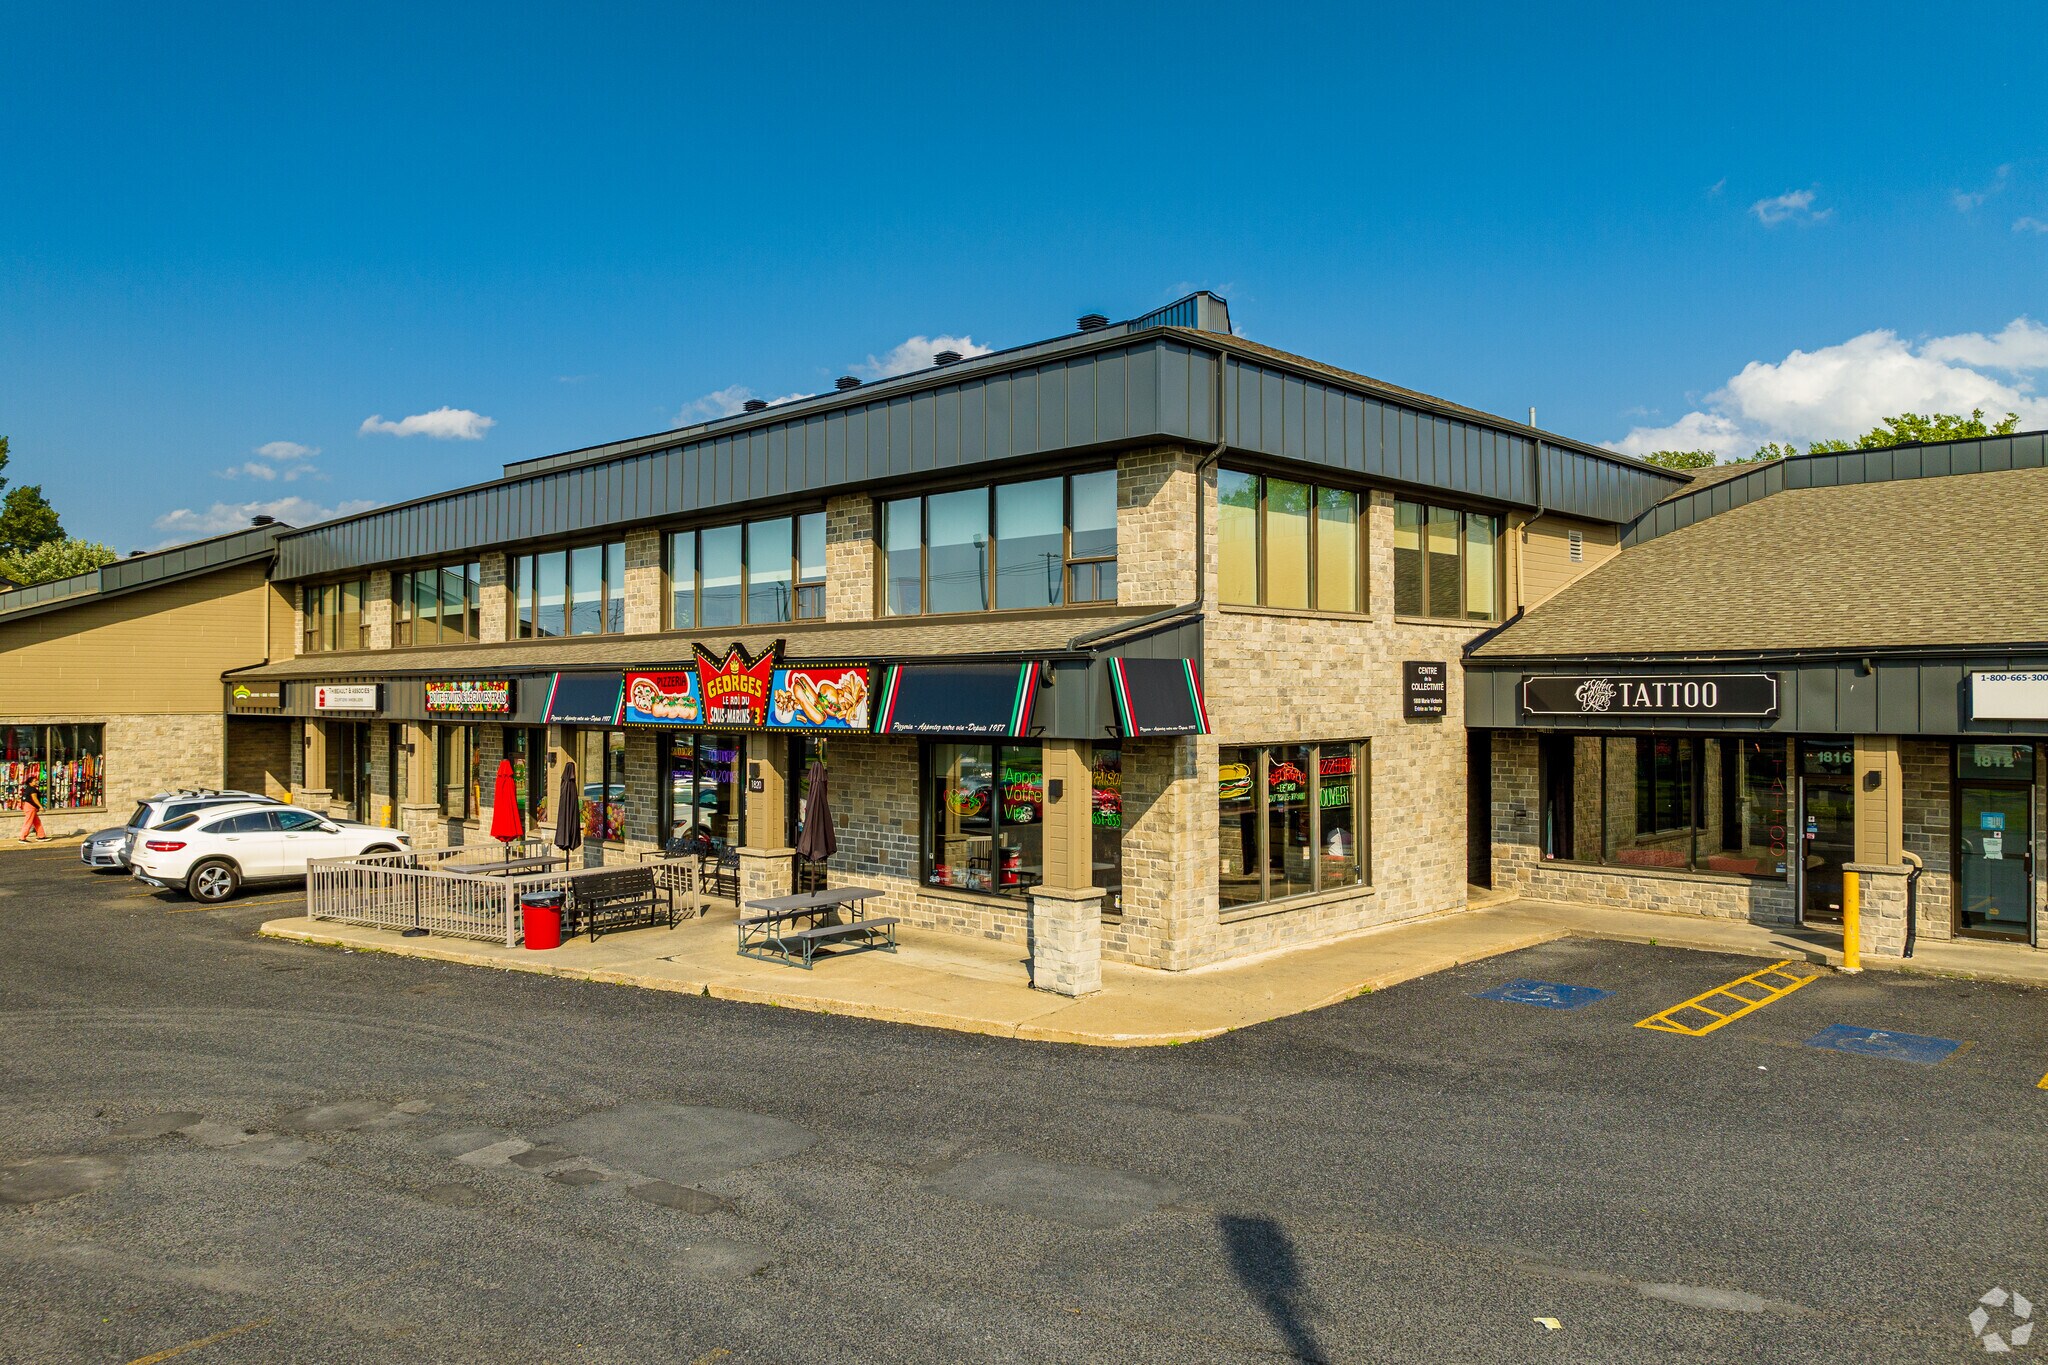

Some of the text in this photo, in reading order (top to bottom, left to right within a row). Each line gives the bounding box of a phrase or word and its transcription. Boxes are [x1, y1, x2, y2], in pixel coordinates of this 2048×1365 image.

[657, 676, 686, 687] PIZZERIA
[707, 674, 762, 698] GEORGES
[1411, 682, 1444, 690] COLLECTIVITÉ
[490, 691, 506, 704] FRAIS
[722, 696, 729, 705] LE
[741, 696, 750, 705] DU
[1619, 681, 1717, 708] TATTOO
[710, 706, 750, 723] SOUS-MARINS
[893, 722, 913, 731] Pizzeria
[918, 722, 941, 732] Apportez
[989, 724, 1006, 732] 1987
[1818, 751, 1852, 764] 1816
[1977, 755, 2014, 767] 1812
[751, 780, 762, 789] 1820
[1004, 784, 1042, 802] Votre
[1320, 786, 1349, 807] OUVERT
[1770, 760, 1785, 857] TATTOO
